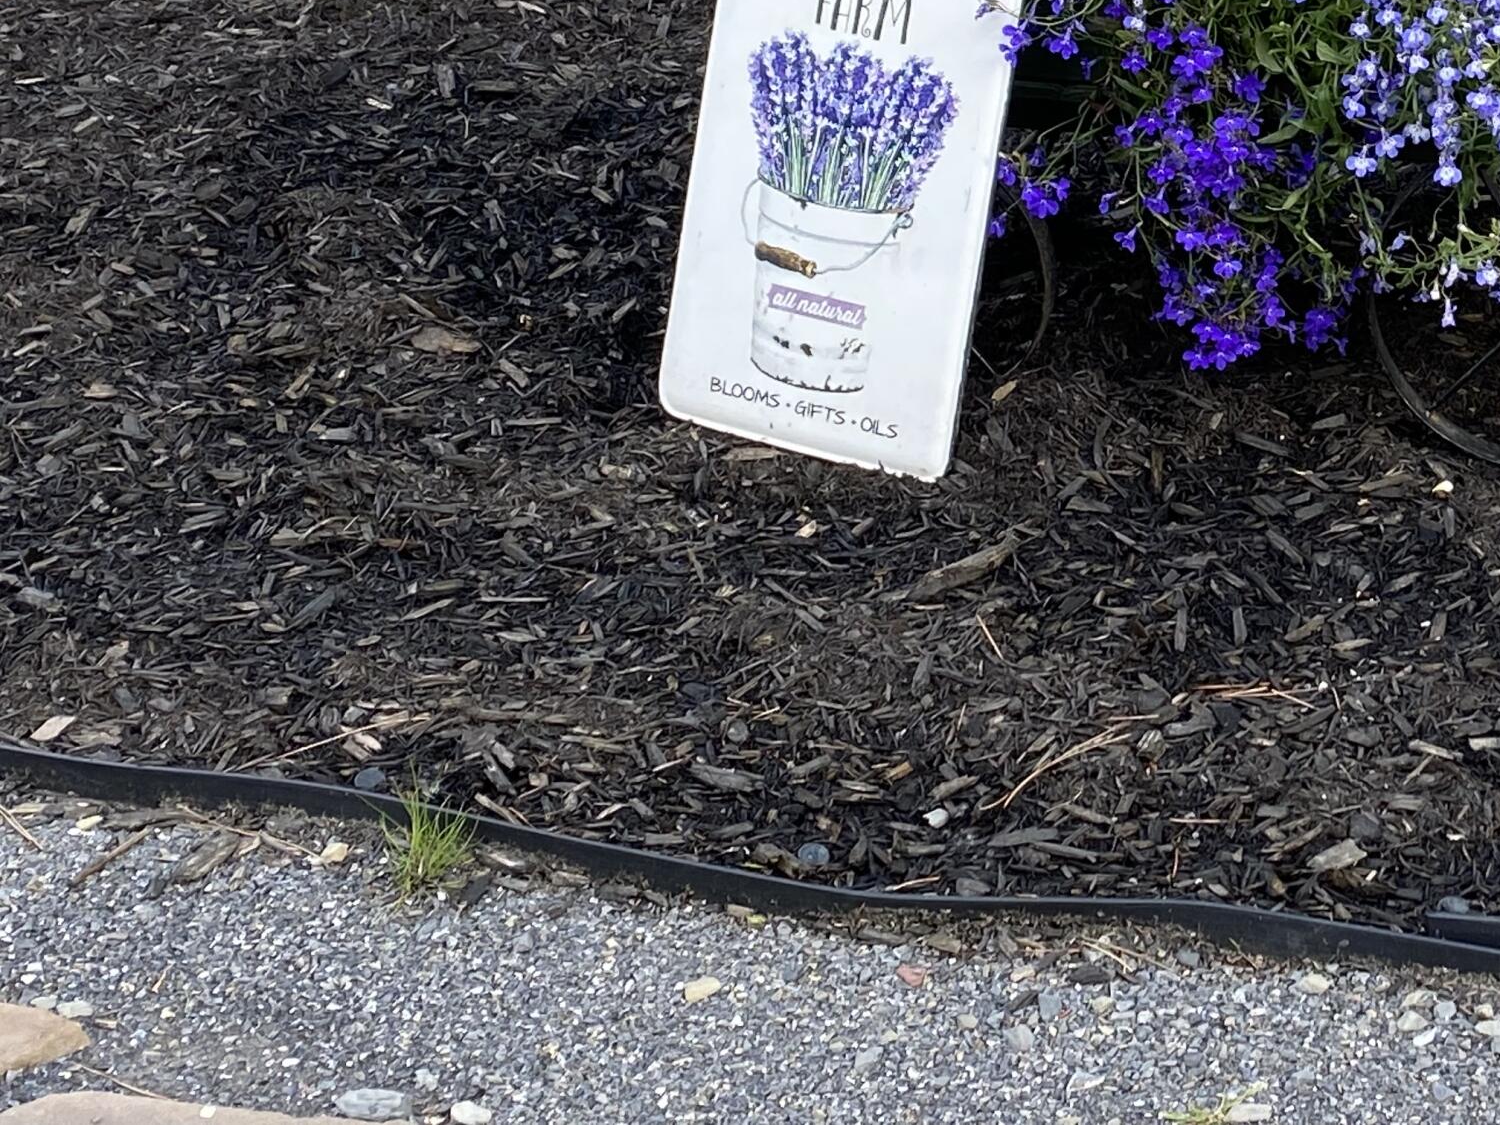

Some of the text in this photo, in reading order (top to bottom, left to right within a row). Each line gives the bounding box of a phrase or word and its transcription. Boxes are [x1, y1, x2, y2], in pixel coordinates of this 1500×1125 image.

[772, 291, 862, 325] all natural
[710, 377, 899, 439] BLOOMS GIFTS OILS
